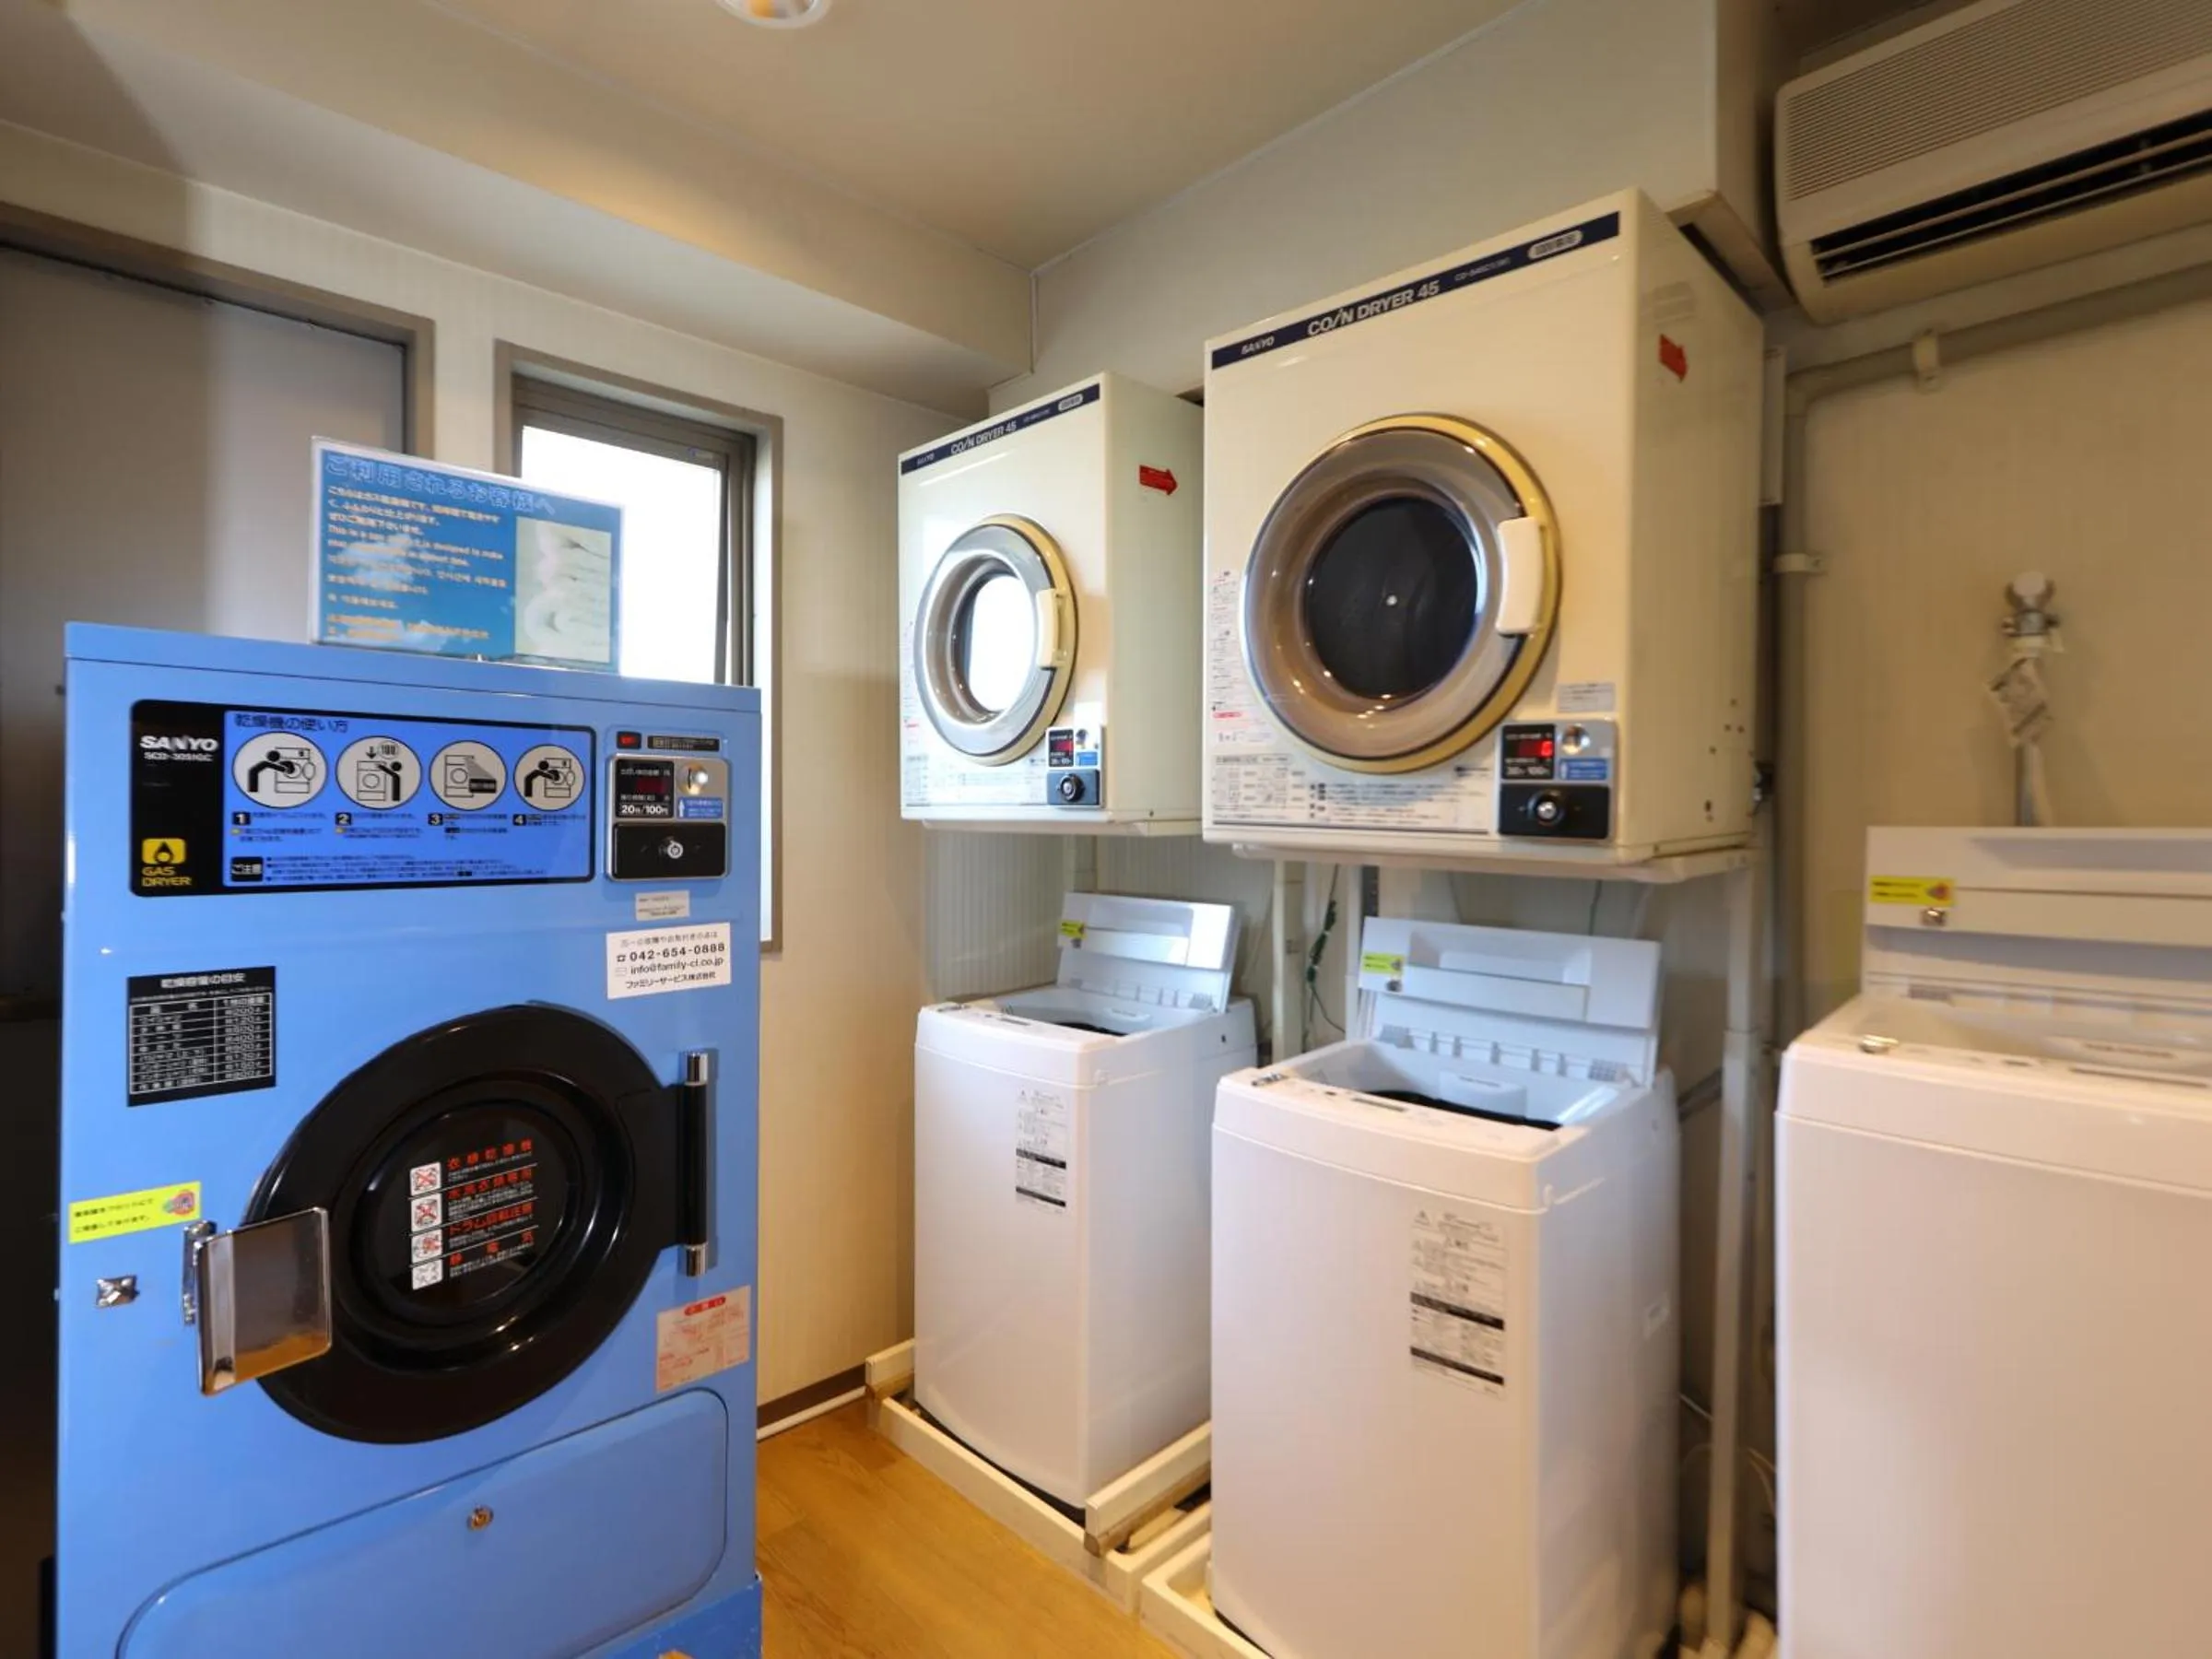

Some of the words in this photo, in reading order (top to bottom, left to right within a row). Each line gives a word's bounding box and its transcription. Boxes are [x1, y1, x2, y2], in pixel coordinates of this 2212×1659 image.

[1241, 335, 1276, 356] SANYO
[1356, 288, 1415, 321] DRYER
[1418, 280, 1441, 300] 45
[139, 735, 218, 752] SANYO
[142, 866, 175, 877] GAS
[142, 877, 192, 887] DRYER
